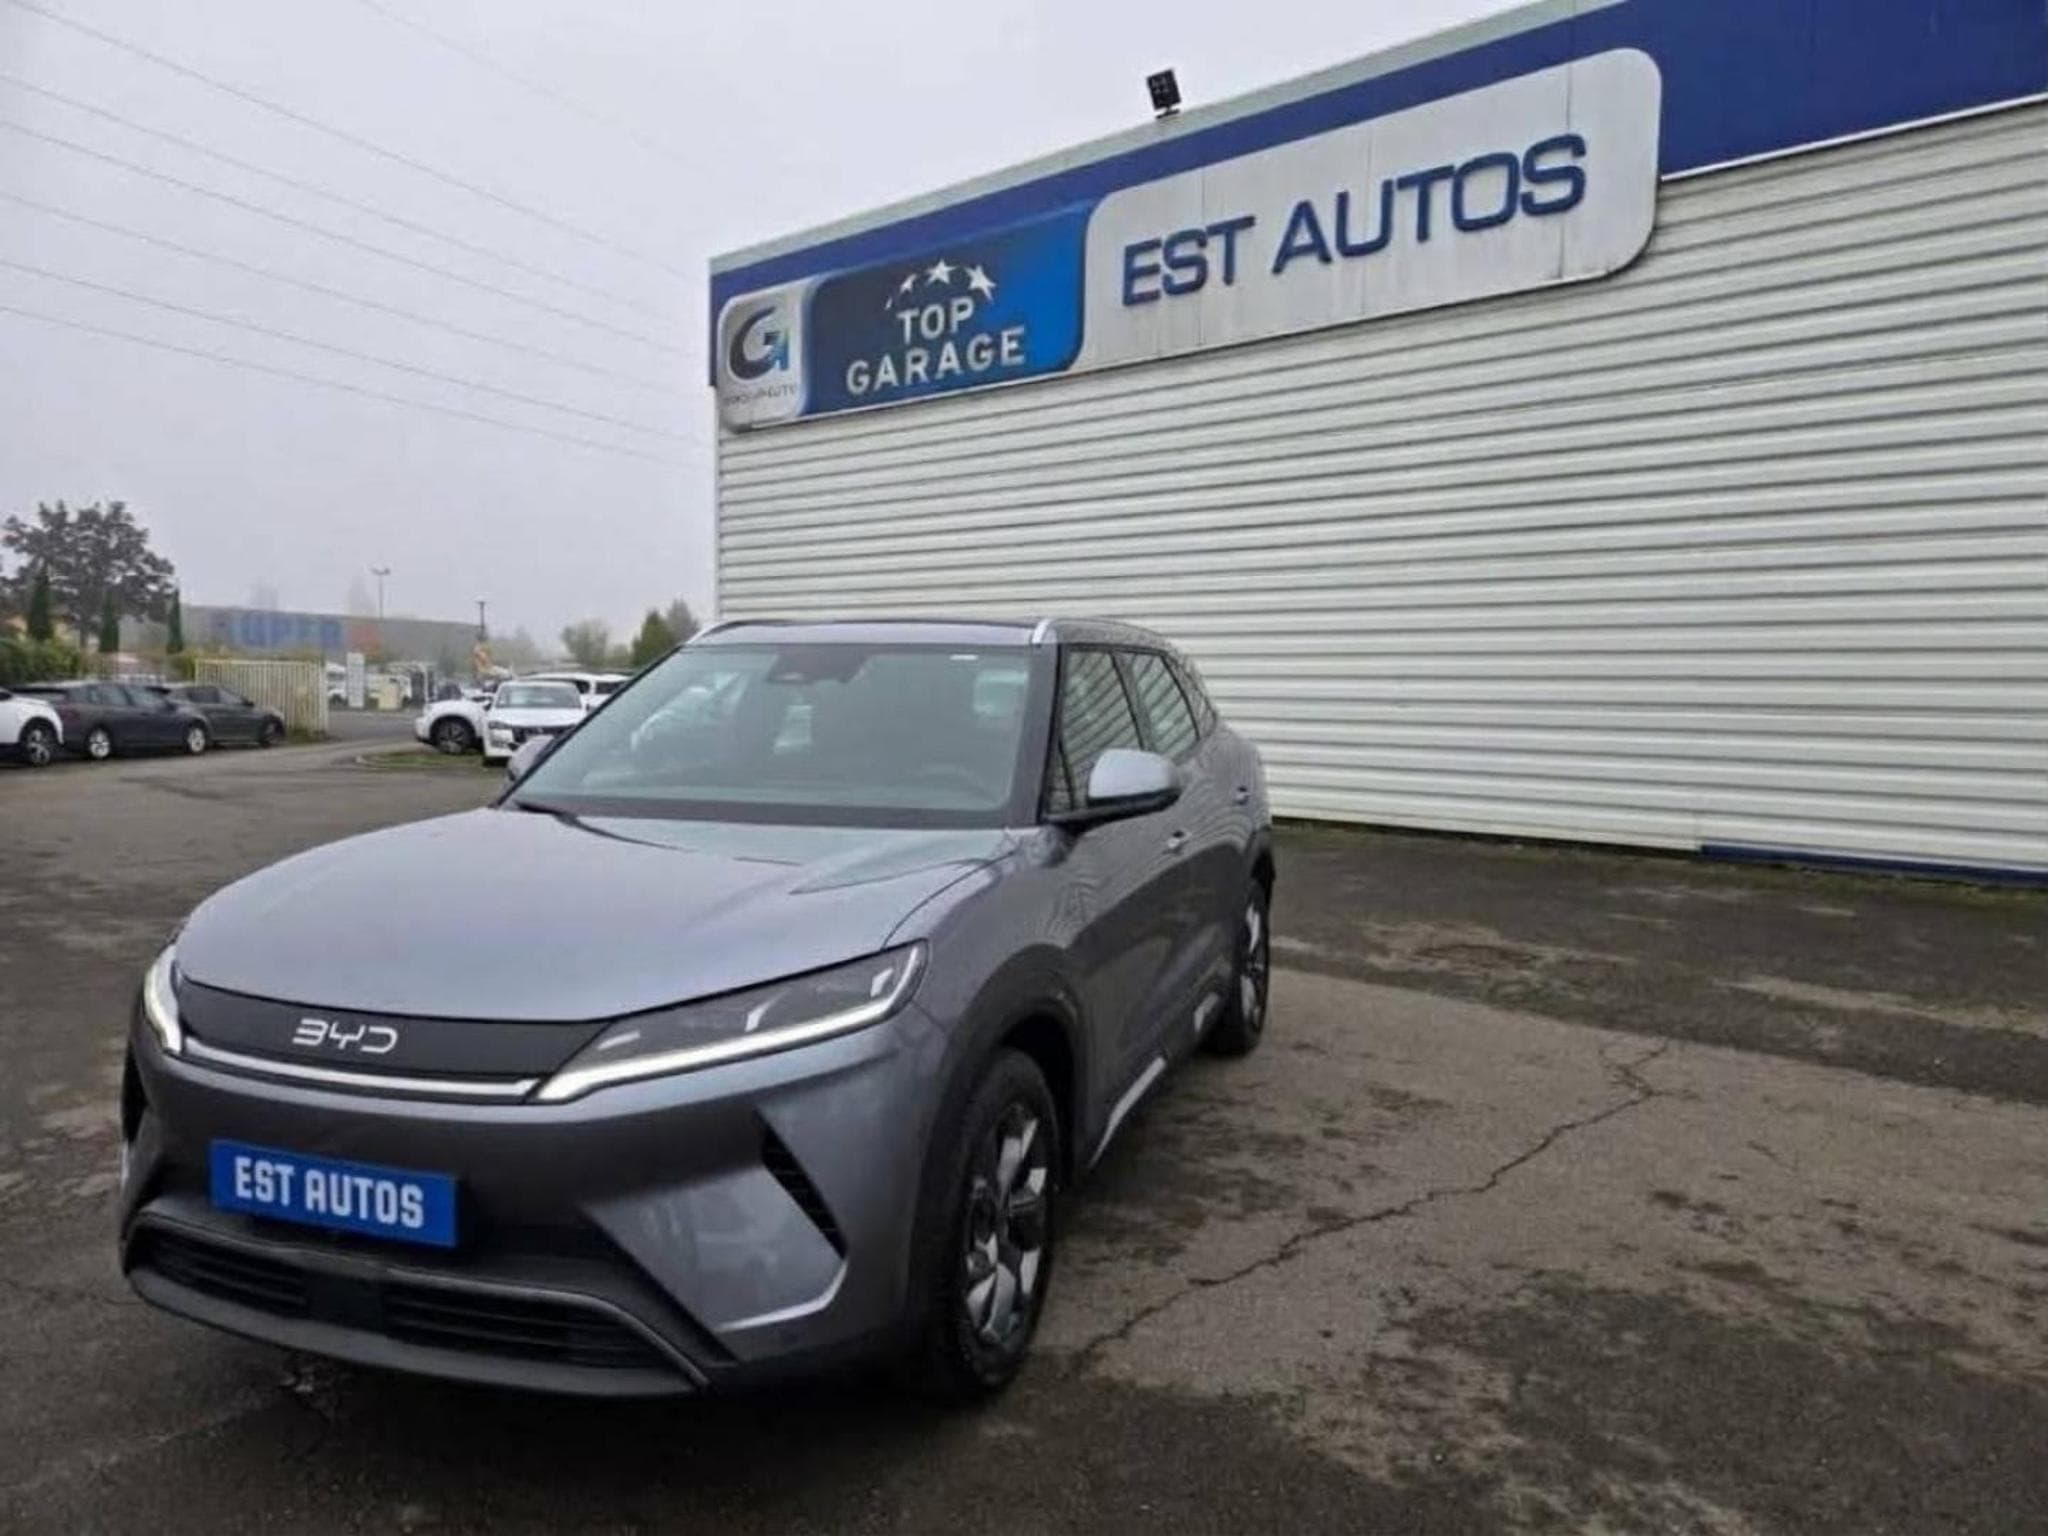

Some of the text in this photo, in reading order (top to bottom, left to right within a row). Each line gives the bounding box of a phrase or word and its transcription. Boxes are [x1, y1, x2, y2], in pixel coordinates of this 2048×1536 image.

[1122, 133, 1587, 306] EST AUTOS
[896, 297, 975, 343] TOP
[845, 325, 1027, 395] GARAGE
[292, 1018, 398, 1054] BYD
[234, 1156, 424, 1228] EST AUTOS
